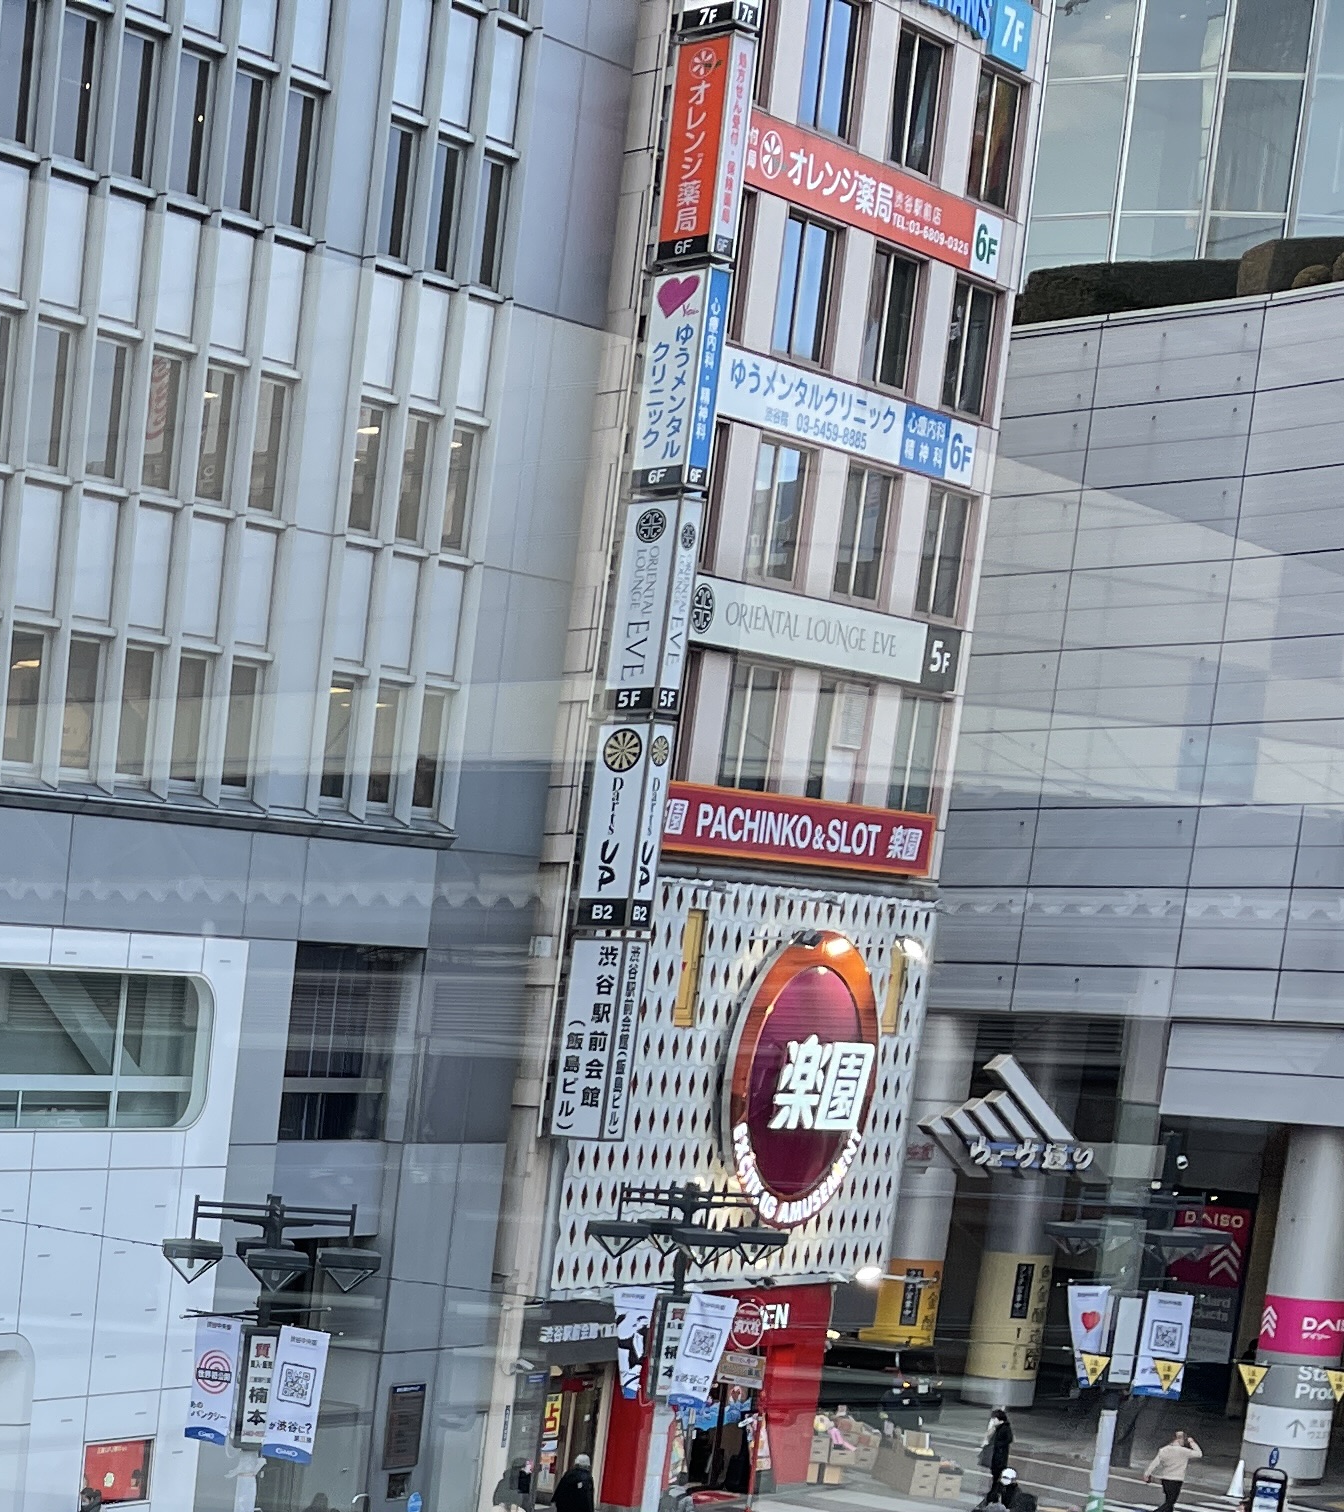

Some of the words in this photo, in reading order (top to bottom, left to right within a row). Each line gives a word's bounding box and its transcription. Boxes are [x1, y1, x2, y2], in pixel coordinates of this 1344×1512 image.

[699, 8, 718, 26] 7F
[740, 5, 753, 21] 7F
[1002, 5, 1025, 53] 7F
[673, 80, 711, 234] オレンジ薬局
[788, 148, 894, 224] オレンジ薬局
[674, 238, 693, 254] 6F
[716, 239, 729, 252] 6F
[975, 223, 998, 265] 6F
[643, 341, 670, 450] クリニック
[662, 323, 694, 460] ゆうメンタル
[730, 358, 897, 434] ゆうメンタルクリニック
[907, 411, 947, 443] 心療内科
[648, 468, 667, 484] 6F
[690, 468, 702, 483] 6F
[949, 431, 973, 473] 6F
[630, 549, 647, 610] LOUNGE
[641, 545, 660, 621] ORIENTAL
[620, 620, 650, 682] EVE
[665, 616, 685, 667] EVE
[725, 600, 800, 642] ORIENTAL
[806, 617, 867, 653] LOUNGE
[872, 631, 898, 658] EVE
[928, 640, 951, 674] 5F
[617, 690, 641, 708] 5F
[659, 690, 676, 706] 5F
[607, 777, 624, 836] Darts
[647, 777, 661, 837] Darts
[664, 798, 690, 835] 園
[695, 802, 883, 858] PACHINKO&SLOT
[597, 839, 620, 893] UP
[637, 840, 655, 894] UP
[886, 824, 924, 862] 楽園
[591, 904, 613, 920] B2
[632, 905, 647, 922] B2
[580, 945, 619, 1109] 渋谷駅前会館
[556, 1019, 586, 1131] （飯島ビル）
[766, 1033, 876, 1131] 楽園
[255, 1342, 271, 1358] 質
[246, 1386, 269, 1426] 楠本
